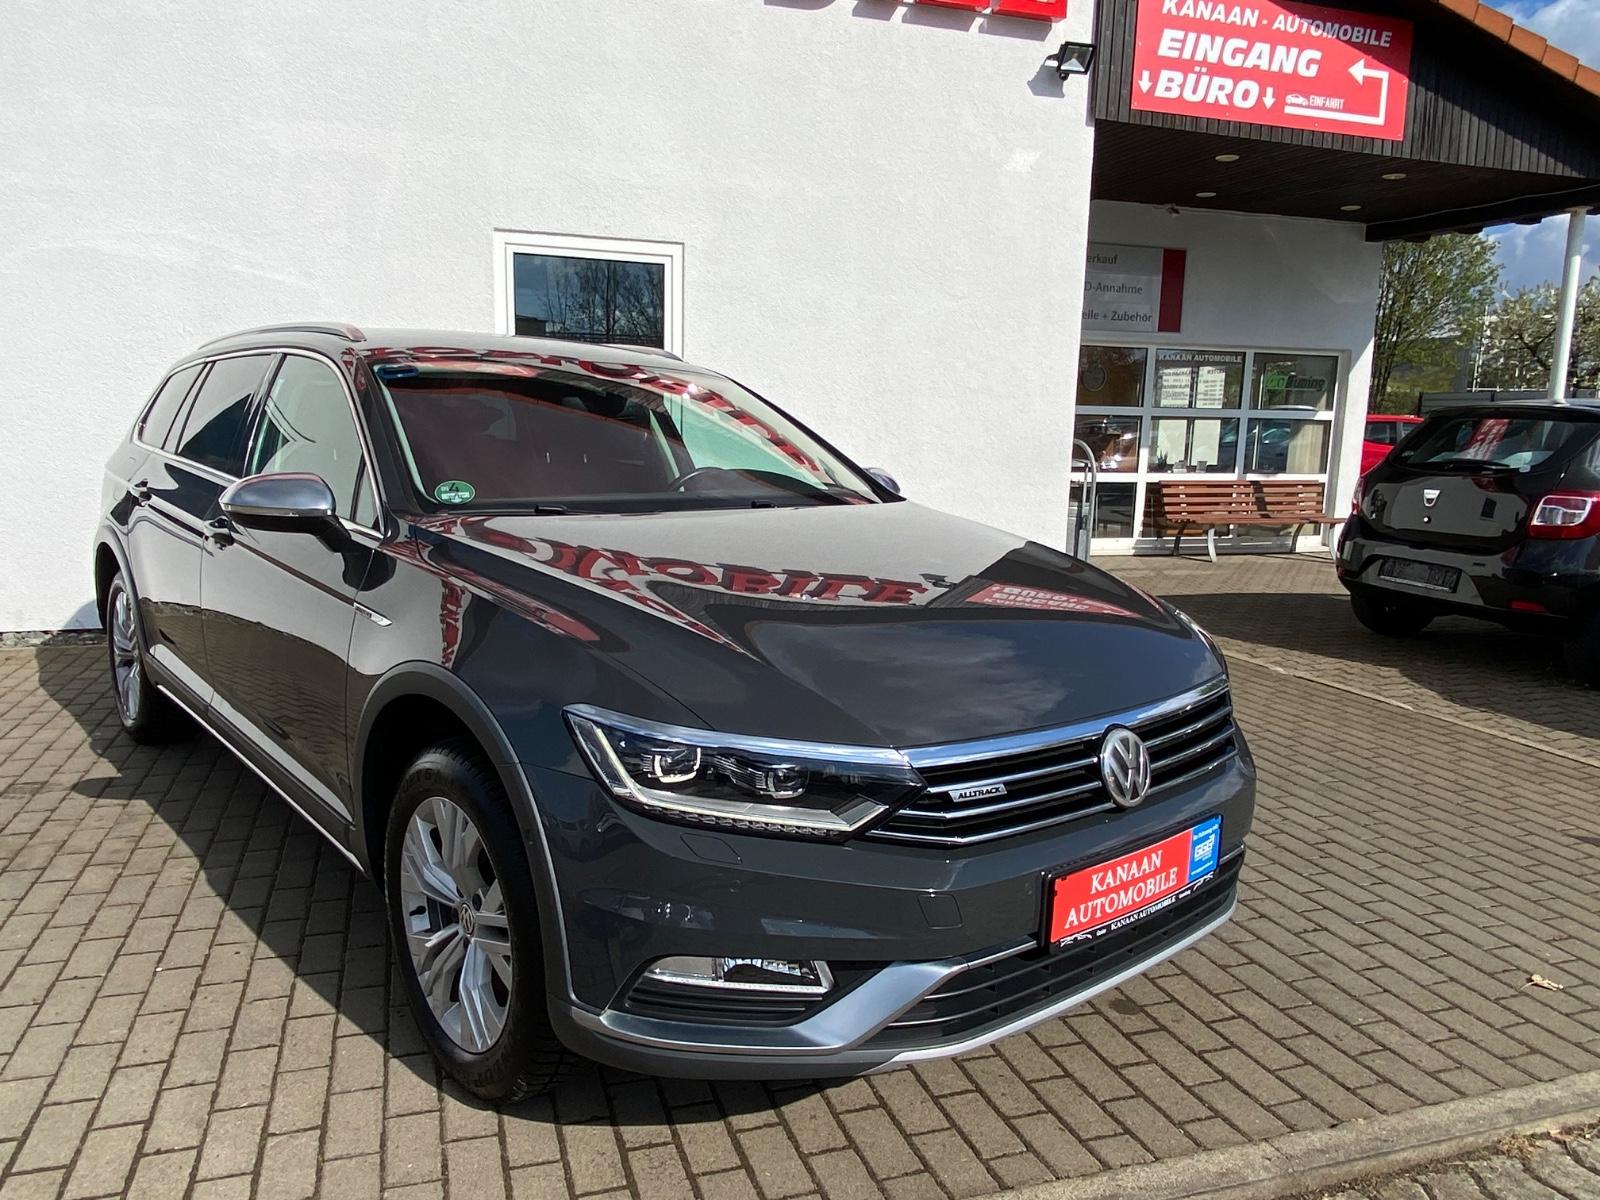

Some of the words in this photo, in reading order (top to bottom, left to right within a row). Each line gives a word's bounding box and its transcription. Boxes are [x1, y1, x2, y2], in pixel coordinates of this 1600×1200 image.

[1162, 0, 1259, 28] KANAAN
[1272, 14, 1392, 47] AUTOMOBILE
[1157, 28, 1322, 78] EINGANG
[1154, 66, 1260, 109] BÜRO
[1309, 95, 1345, 110] EINFAHRT
[1111, 309, 1153, 323] Zubehör
[1194, 354, 1242, 363] AUTOMOBILE
[957, 787, 1001, 799] ALLTRACK
[1090, 850, 1163, 894] KANAAN
[1063, 867, 1178, 929] AUTOMOBILE
